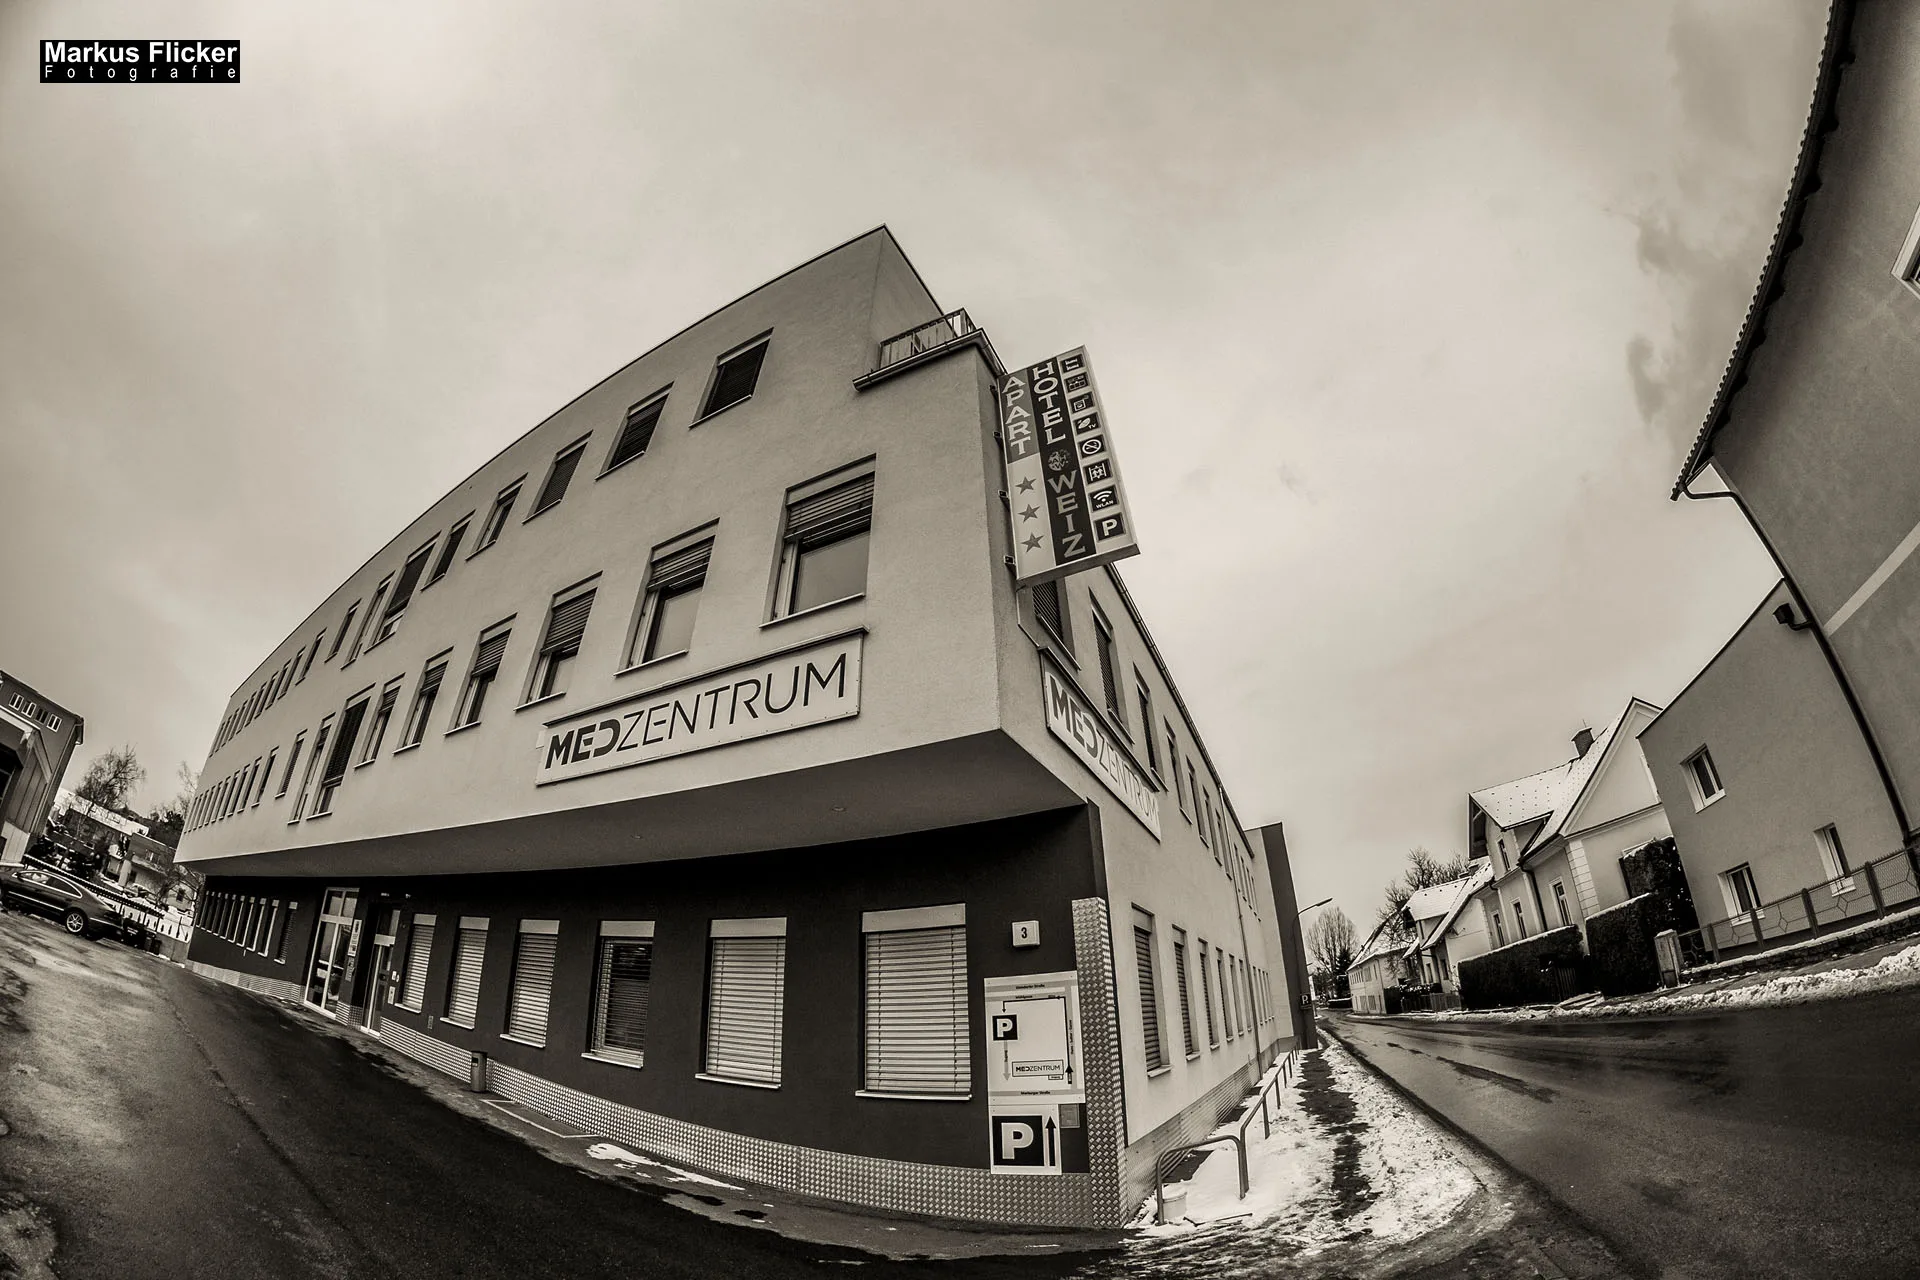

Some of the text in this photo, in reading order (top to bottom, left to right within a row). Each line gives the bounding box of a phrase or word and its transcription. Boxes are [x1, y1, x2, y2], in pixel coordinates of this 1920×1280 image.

[1002, 376, 1031, 457] APART
[1032, 361, 1066, 446] HOTEL
[1047, 469, 1087, 559] WEIZ
[1095, 500, 1114, 509] WLAN
[1102, 518, 1118, 537] P
[545, 652, 847, 770] MEDZENTRUM
[1021, 926, 1028, 939] 3
[996, 1018, 1014, 1038] P
[1015, 1064, 1061, 1073] MEDZENTRUM
[1001, 1122, 1034, 1160] P
